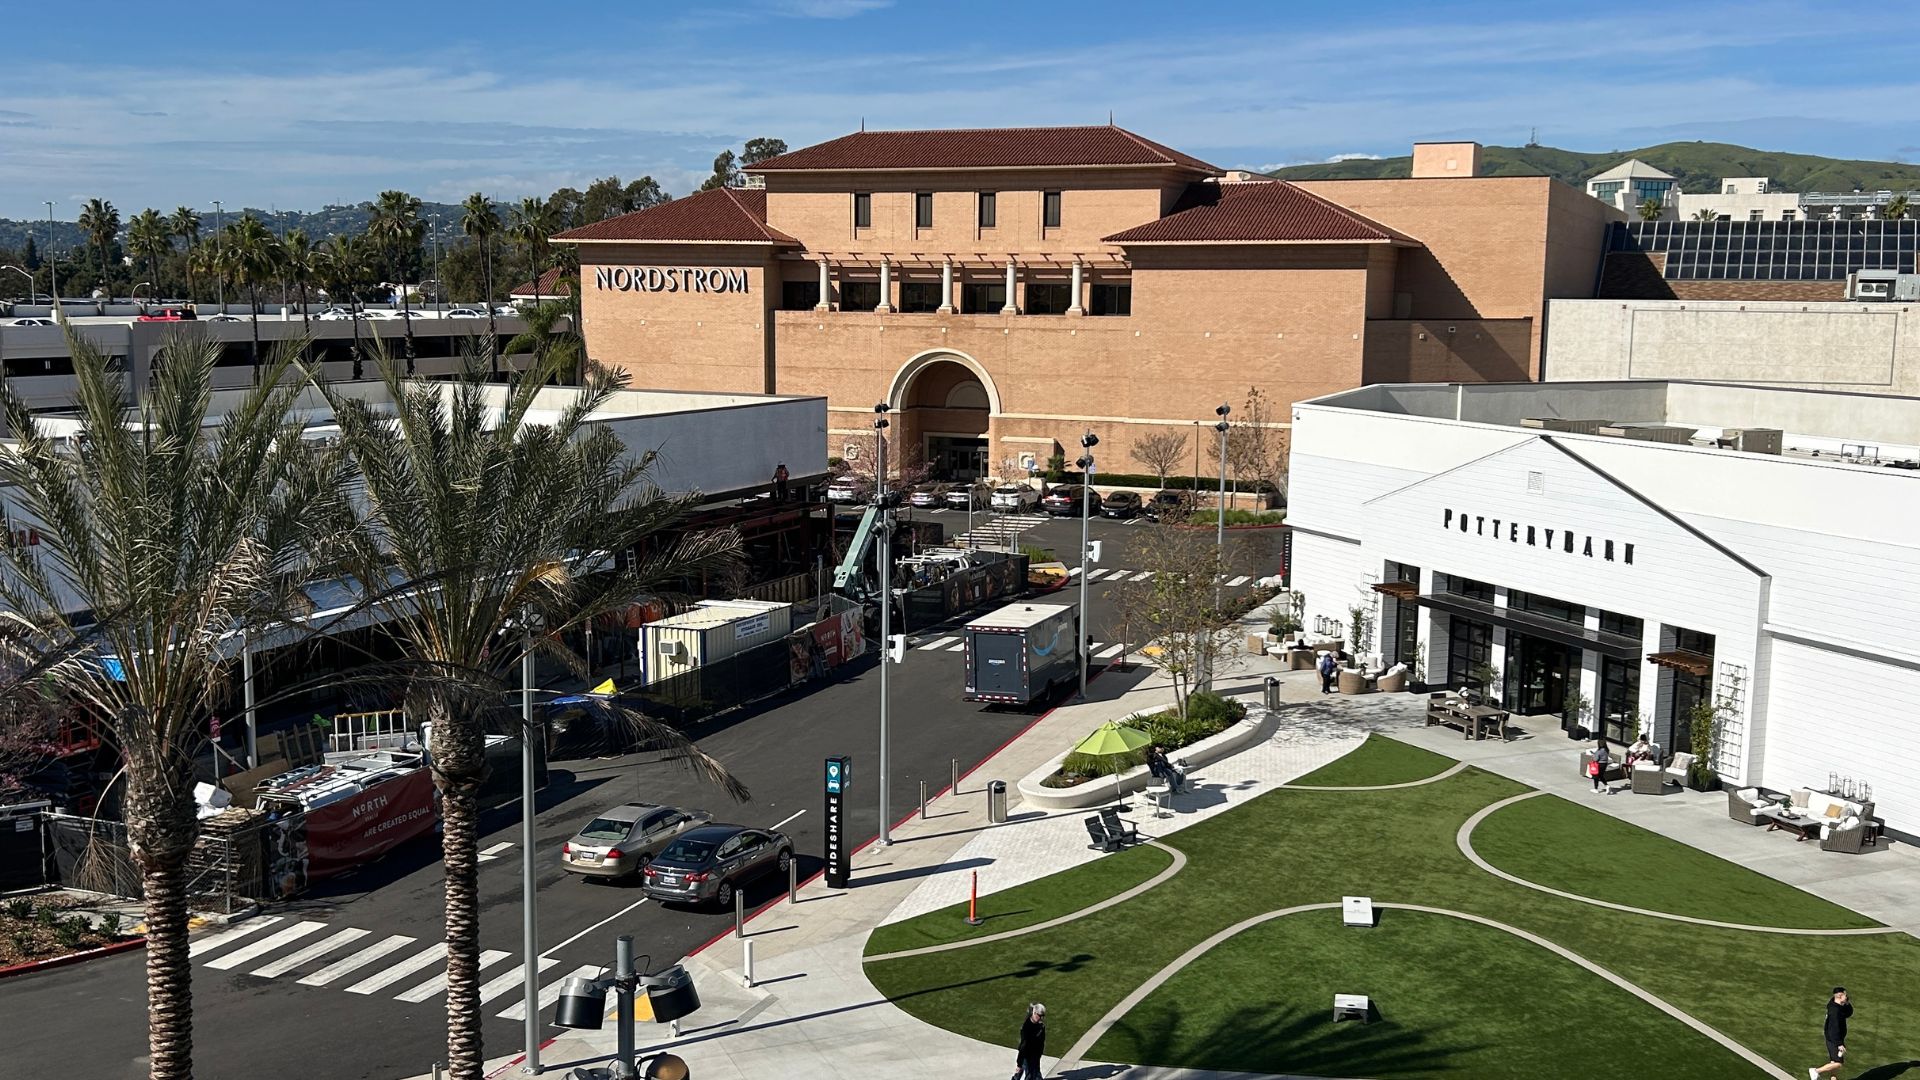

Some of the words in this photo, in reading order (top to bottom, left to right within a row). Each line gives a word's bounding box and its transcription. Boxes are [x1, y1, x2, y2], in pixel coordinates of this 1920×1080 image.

[595, 266, 749, 294] NORDSTROM
[352, 795, 388, 817] NORTH
[363, 826, 377, 839] ARE
[378, 815, 407, 831] CREATED
[408, 806, 430, 820] EQUAL
[829, 797, 838, 875] RIDESHARE
